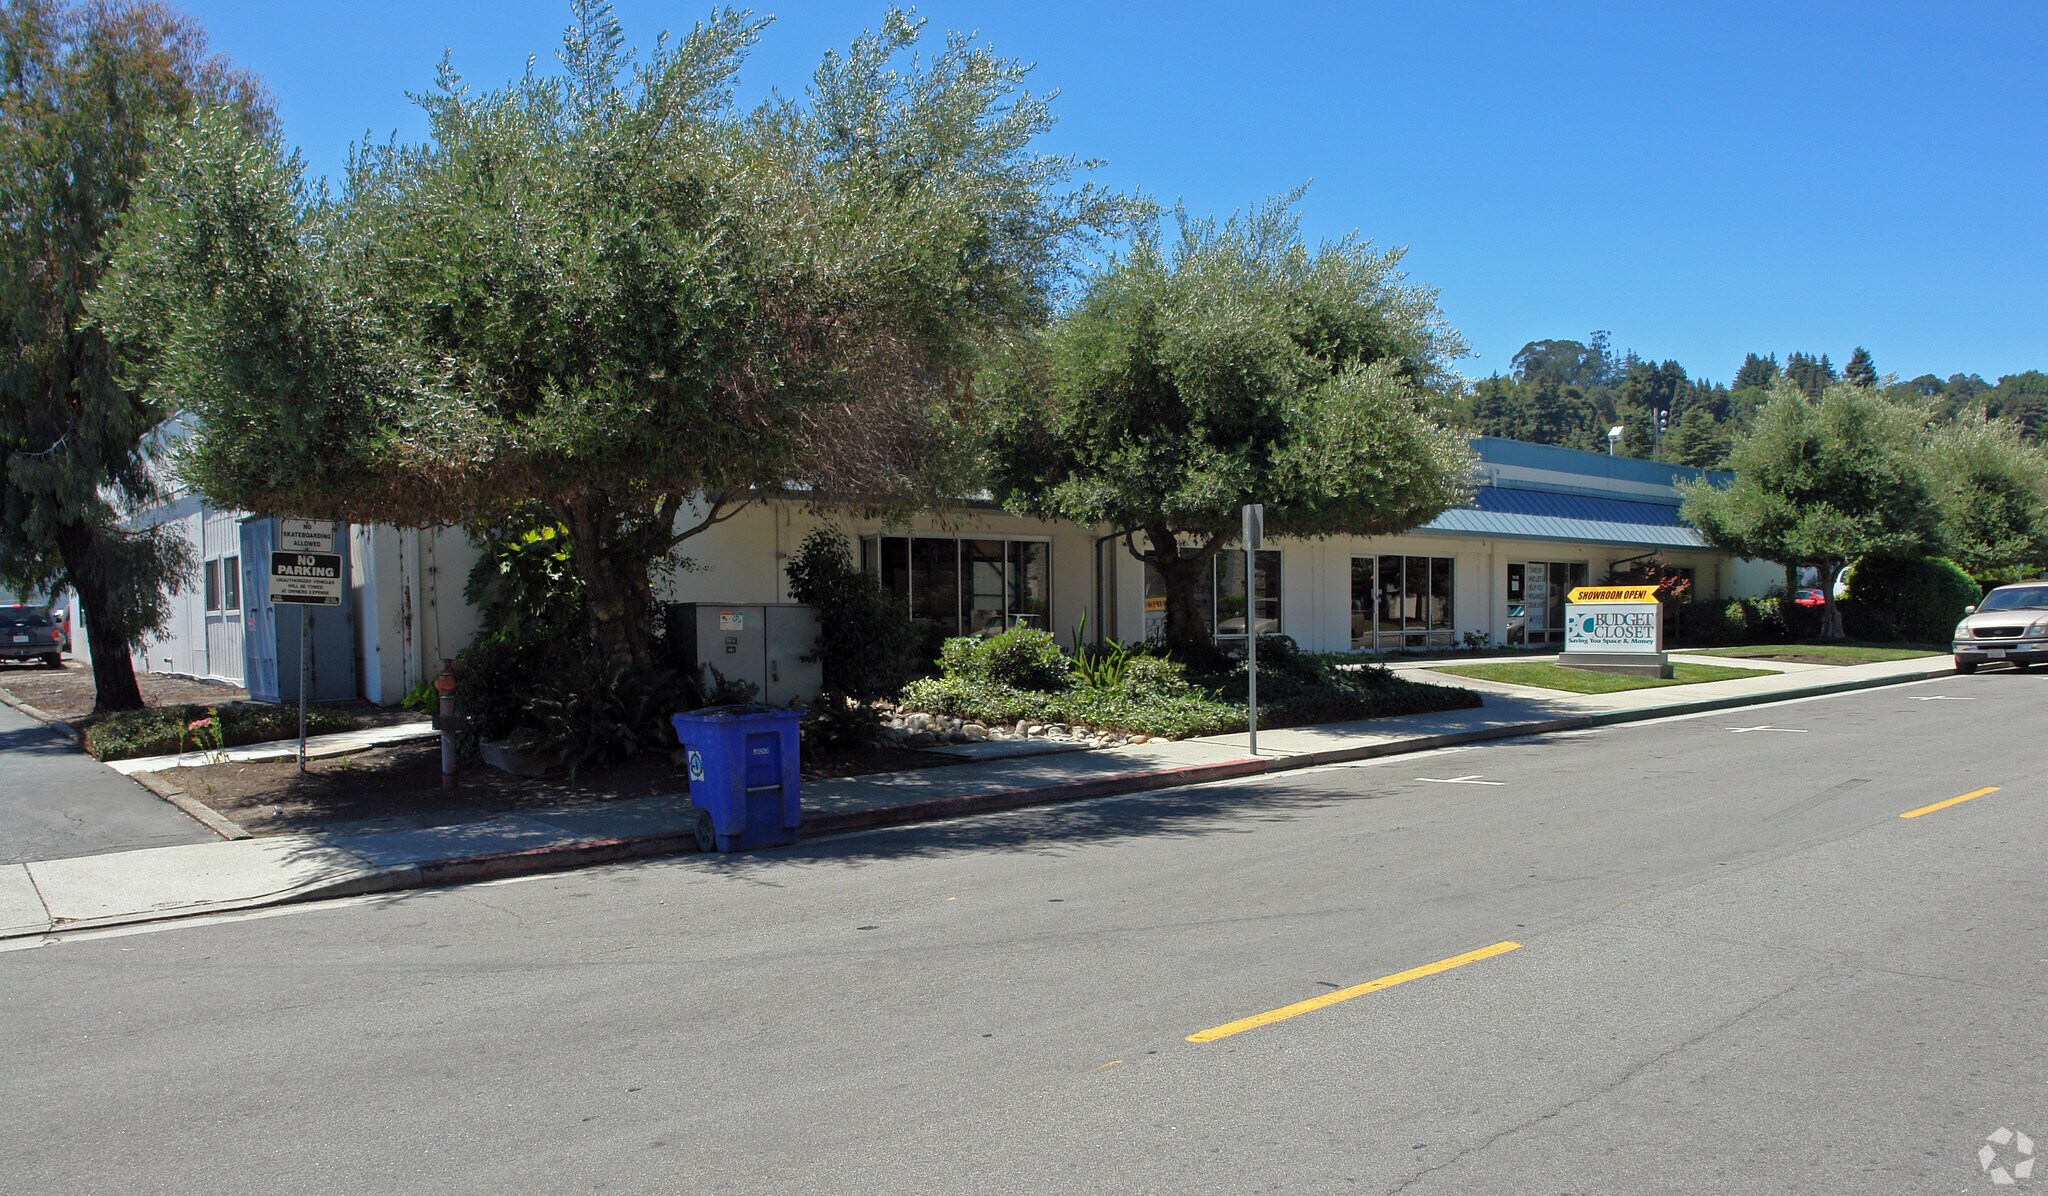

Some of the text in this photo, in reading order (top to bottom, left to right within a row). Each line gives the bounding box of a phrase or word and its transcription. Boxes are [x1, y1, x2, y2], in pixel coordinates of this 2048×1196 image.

[283, 531, 331, 540] SKATEBOARDING
[297, 554, 316, 566] NO
[277, 565, 335, 577] PARKING
[1578, 590, 1647, 600] SHOWROOM OPEN!
[1595, 612, 1654, 626] BUDGET
[1594, 626, 1654, 639] CLOSET
[1631, 638, 1654, 646] Money
